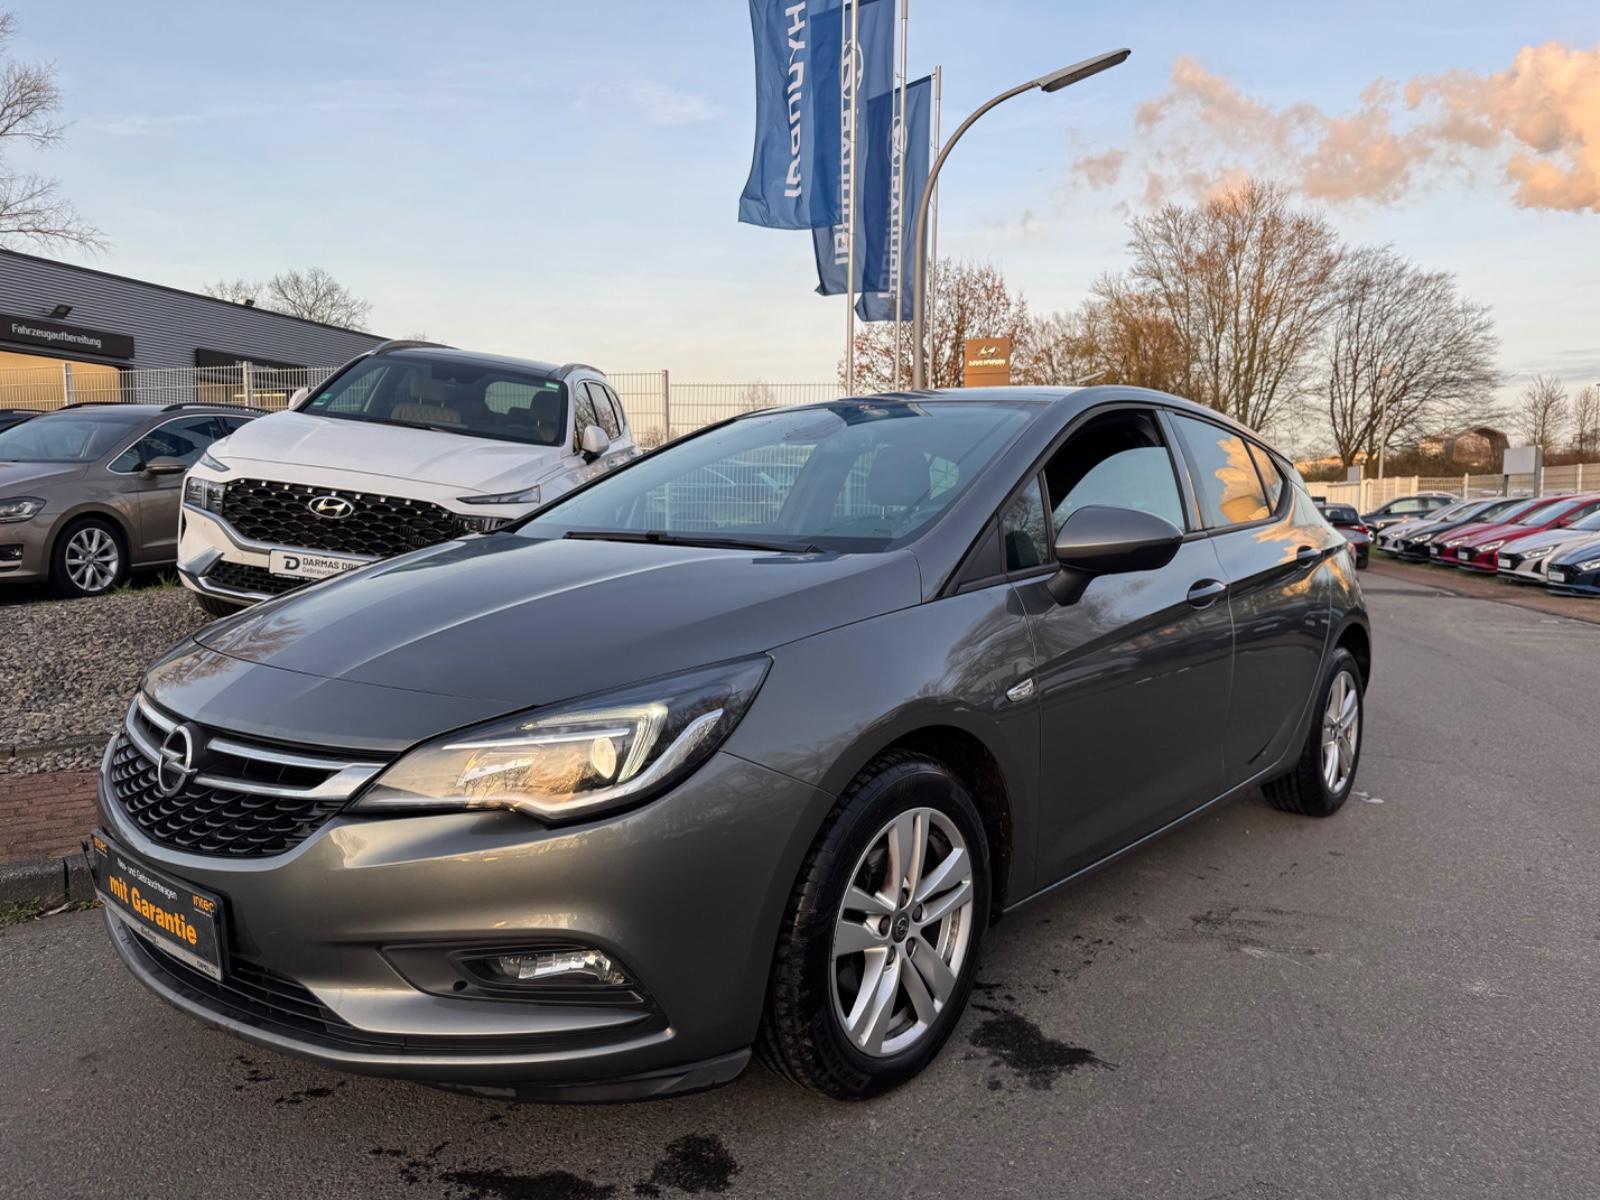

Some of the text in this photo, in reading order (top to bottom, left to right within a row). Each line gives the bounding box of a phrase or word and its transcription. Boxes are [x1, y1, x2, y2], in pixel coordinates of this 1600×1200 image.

[11, 323, 102, 348] Fahrzeugaufbereitung
[302, 558, 339, 569] DARMAS
[109, 874, 198, 945] mit Garantie
